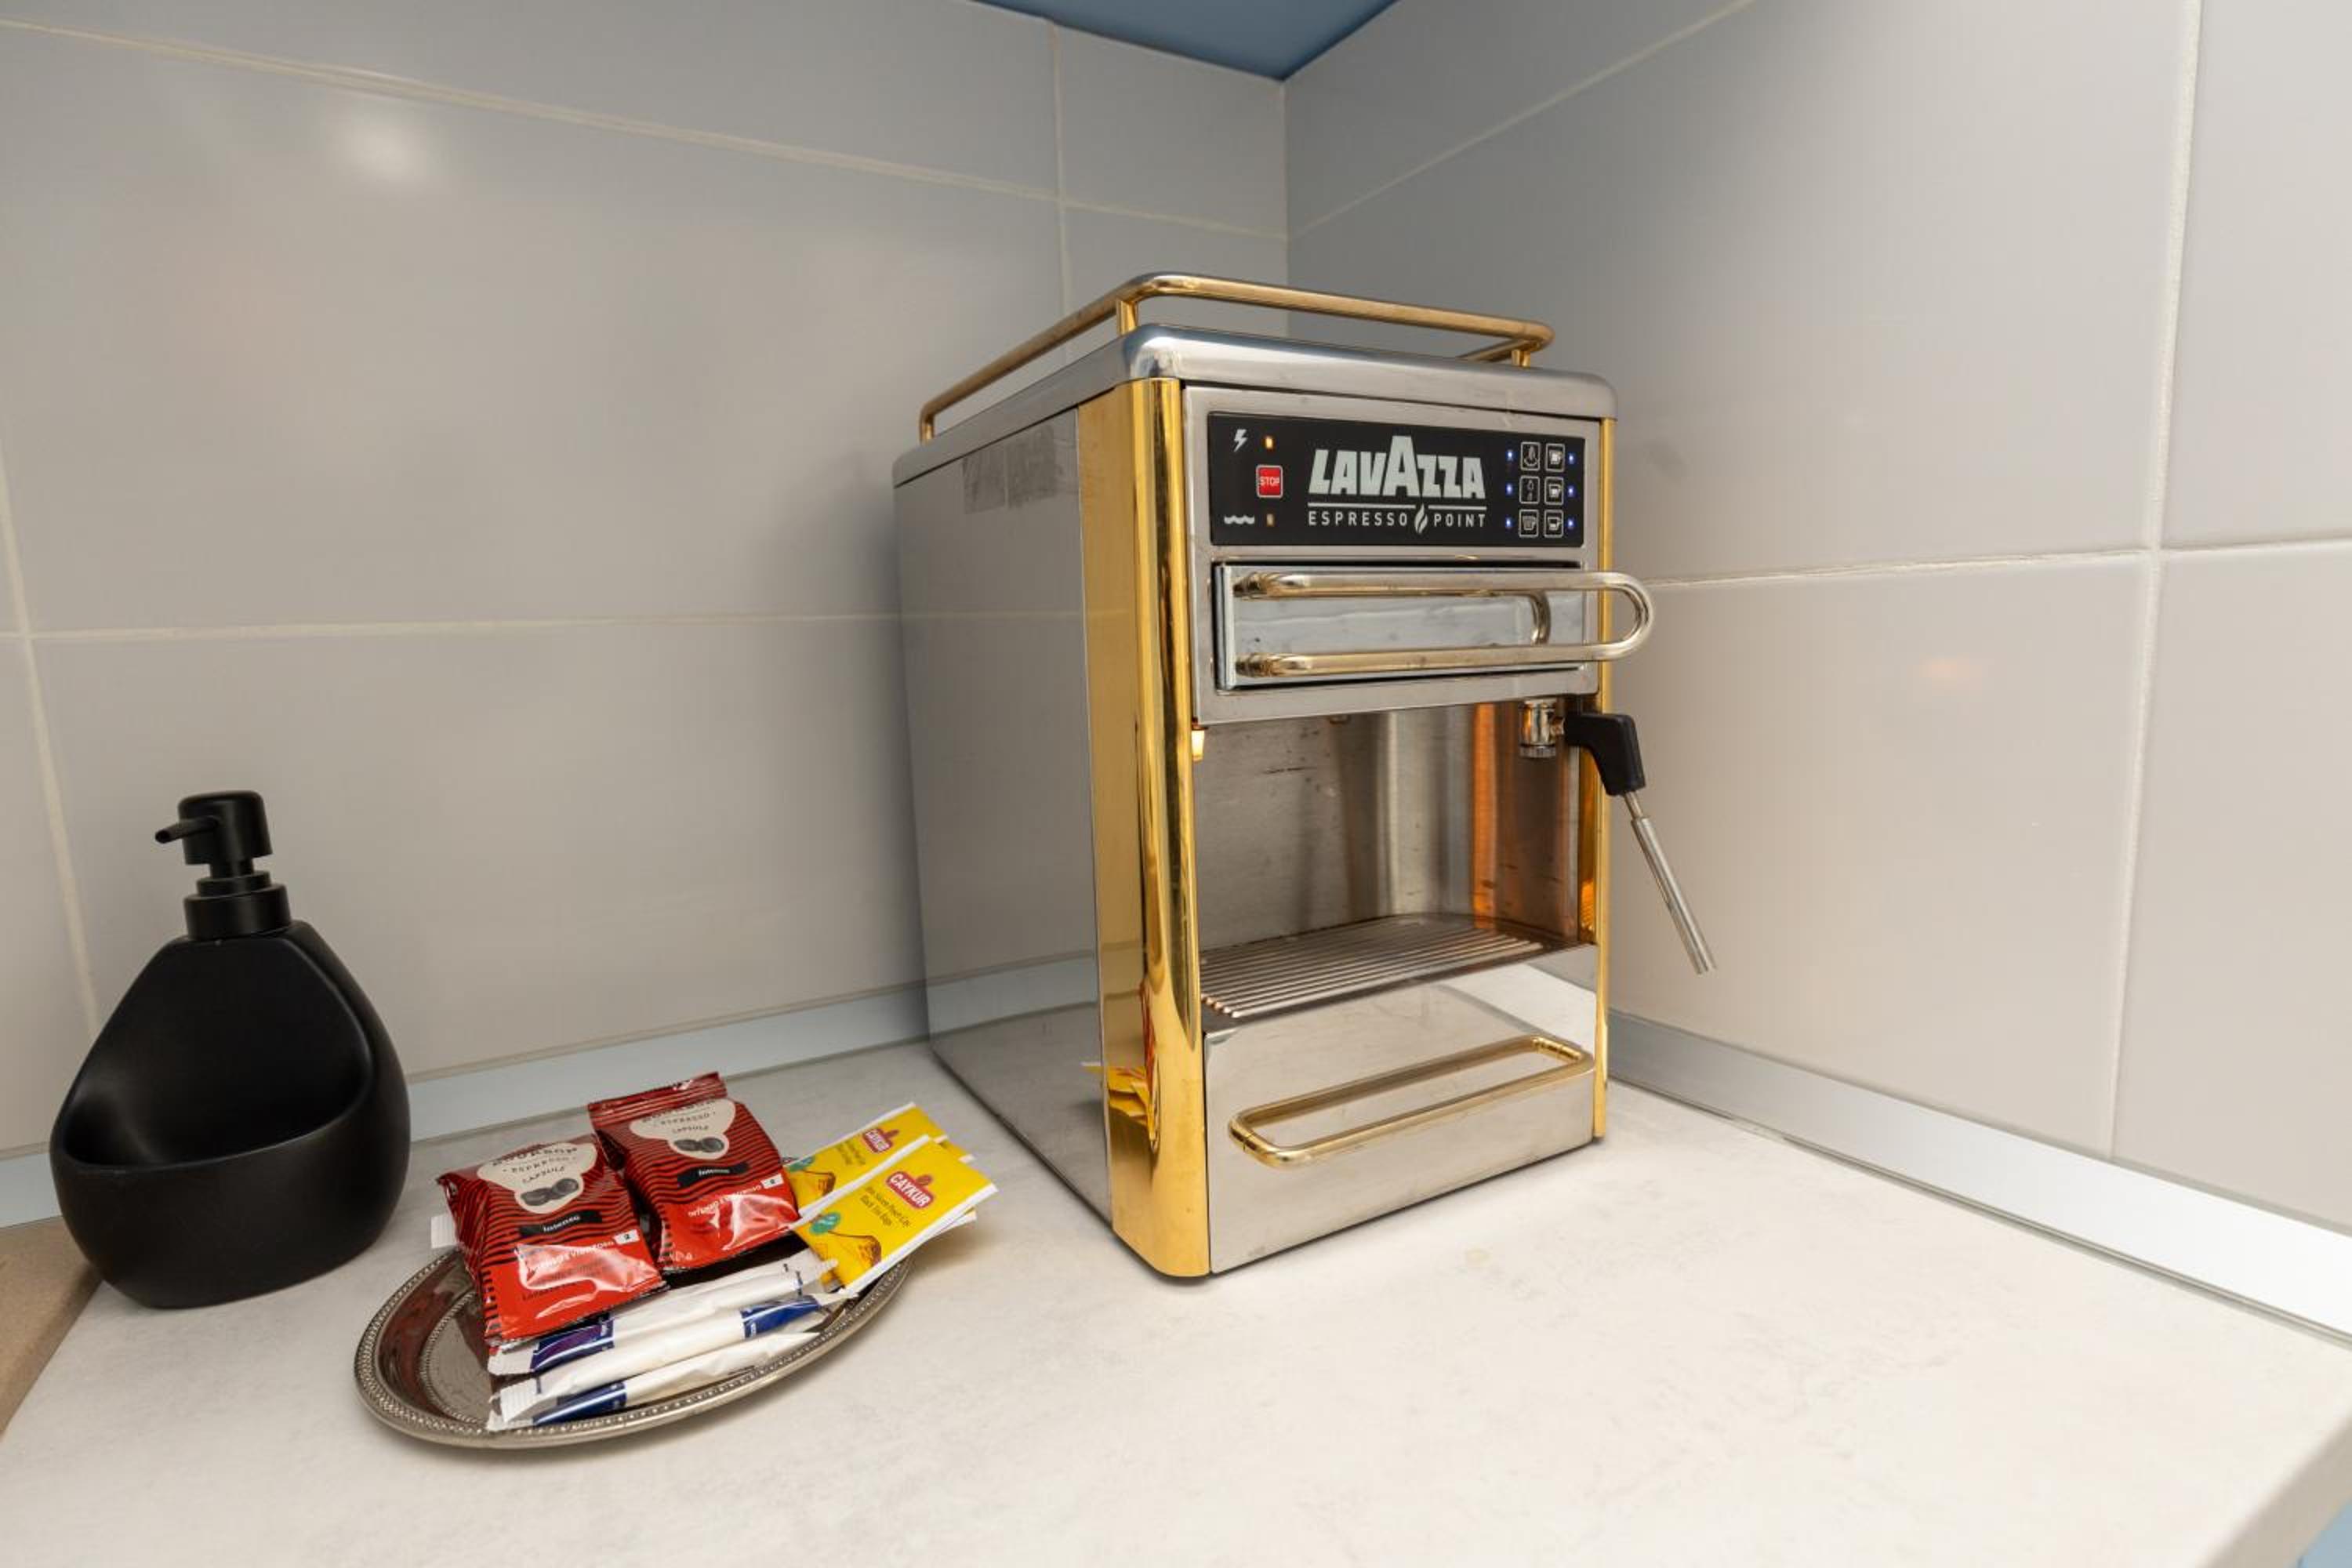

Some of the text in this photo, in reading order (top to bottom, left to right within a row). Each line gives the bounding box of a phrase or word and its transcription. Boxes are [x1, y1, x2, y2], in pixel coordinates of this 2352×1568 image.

[1308, 435, 1486, 499] LAVAZZA
[1259, 476, 1280, 487] STOP
[1308, 512, 1486, 528] ESPRESSO POINT
